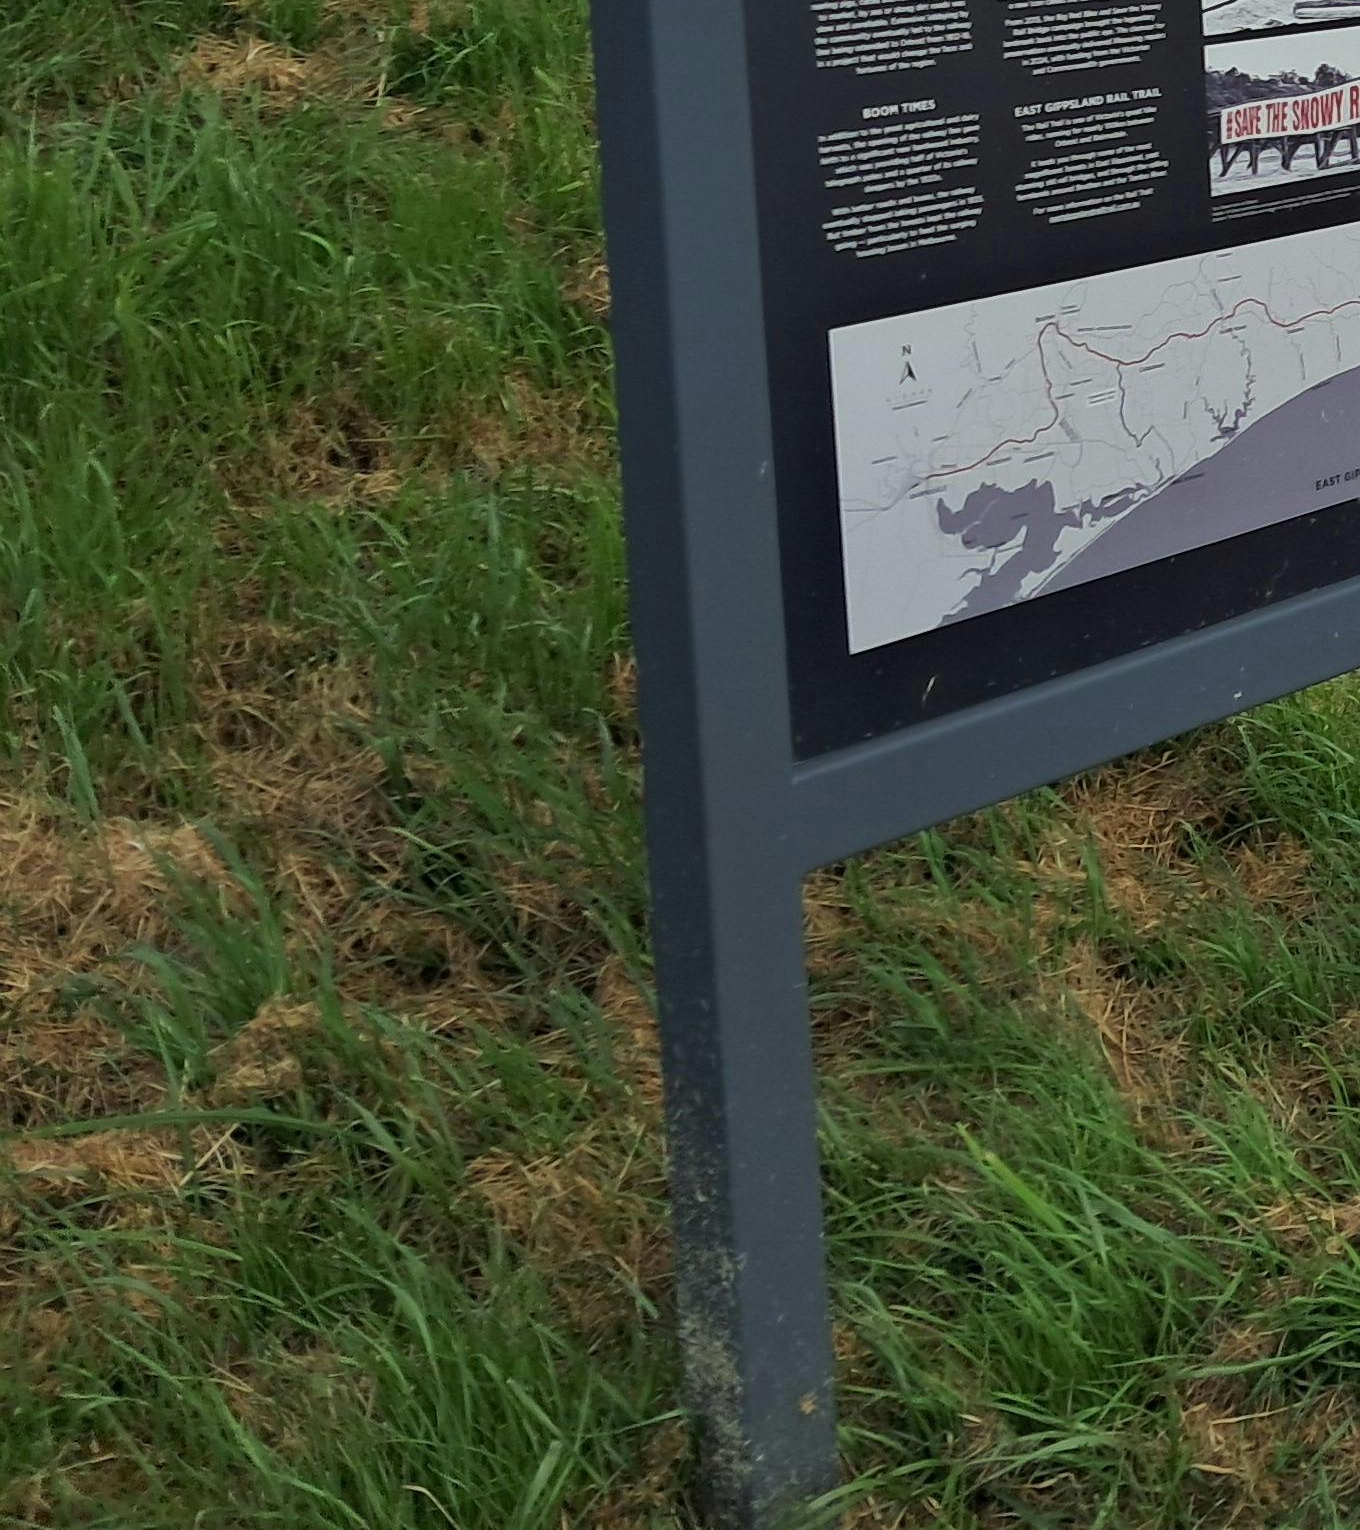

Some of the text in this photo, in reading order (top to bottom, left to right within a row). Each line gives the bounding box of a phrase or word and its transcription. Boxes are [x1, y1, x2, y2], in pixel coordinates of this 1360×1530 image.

[1015, 104, 1042, 117] EAST
[1106, 93, 1130, 103] RAIL
[1132, 88, 1161, 99] TRAIL
[863, 105, 898, 118] BOOM
[1266, 102, 1288, 133] THE
[1293, 90, 1343, 130] SNOWY
[902, 346, 911, 356] N
[1316, 475, 1340, 490] EAST
